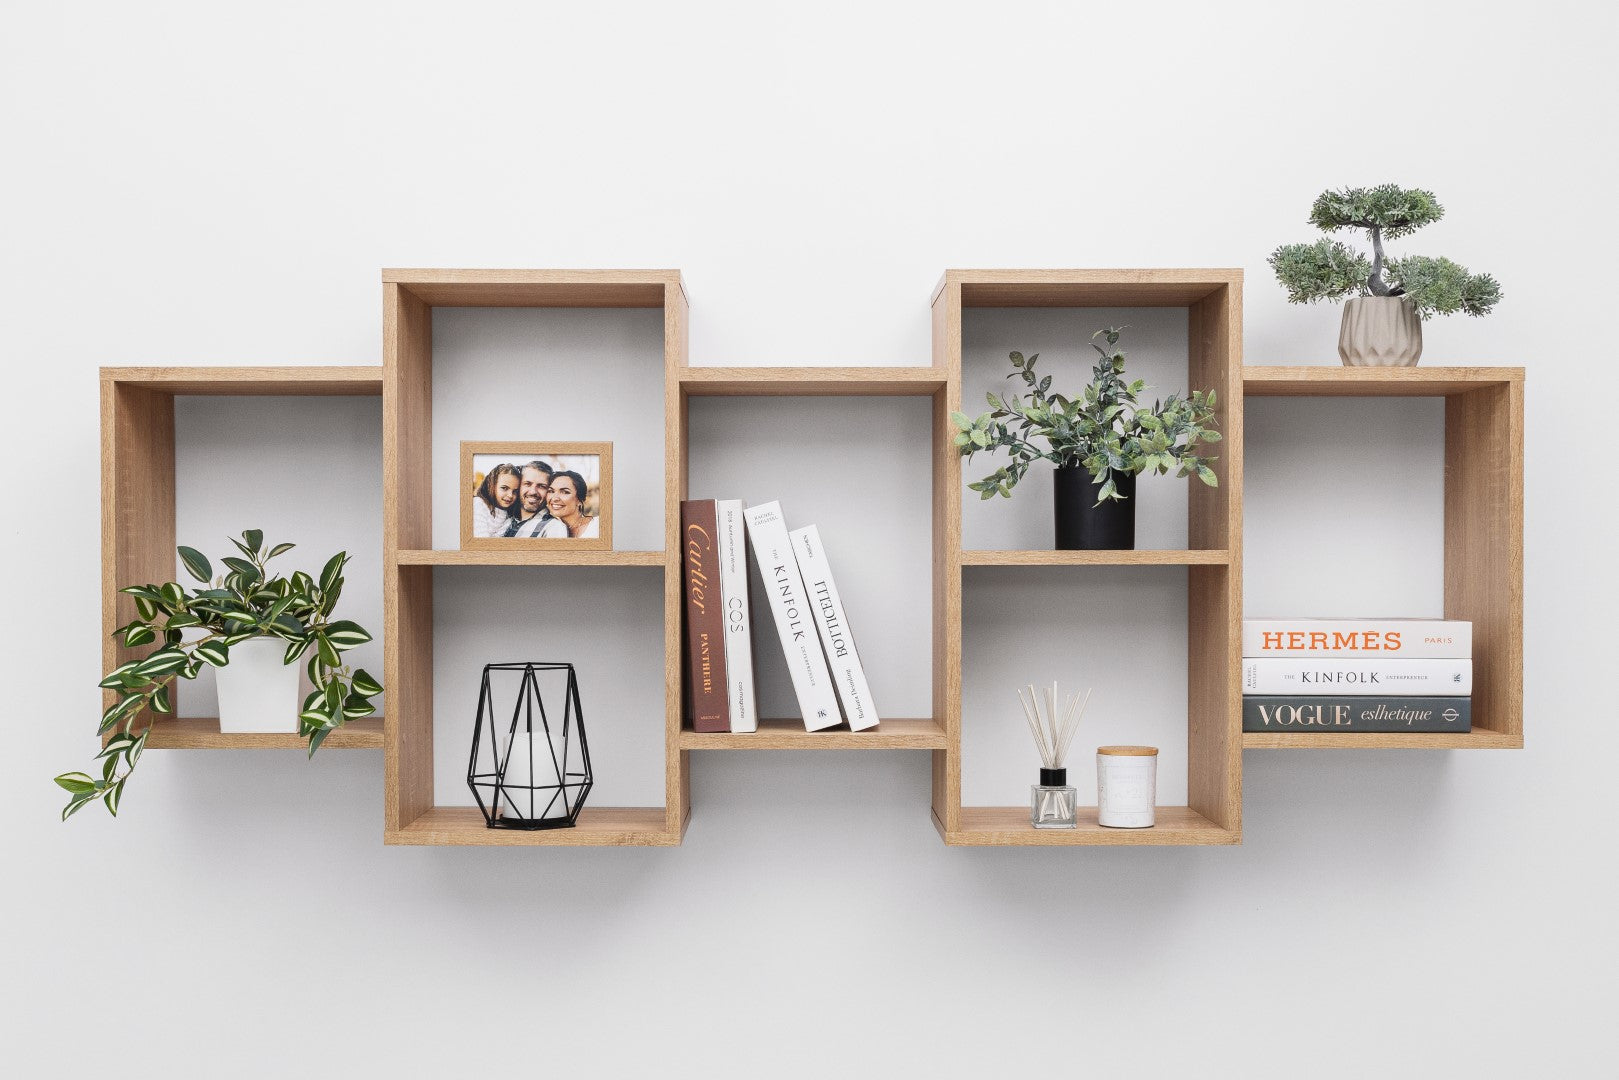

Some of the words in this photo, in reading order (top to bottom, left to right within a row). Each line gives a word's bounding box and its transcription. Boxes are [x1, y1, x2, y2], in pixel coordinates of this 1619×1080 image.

[688, 523, 711, 614] Cartier
[728, 597, 744, 634] COS
[774, 565, 806, 642] KINFOLK
[814, 581, 848, 658] BOTTICELLI
[700, 633, 712, 694] PANTHERE
[1424, 637, 1453, 645] PARIS
[1302, 671, 1380, 683] KINFOLK
[1259, 705, 1352, 726] VOGUE
